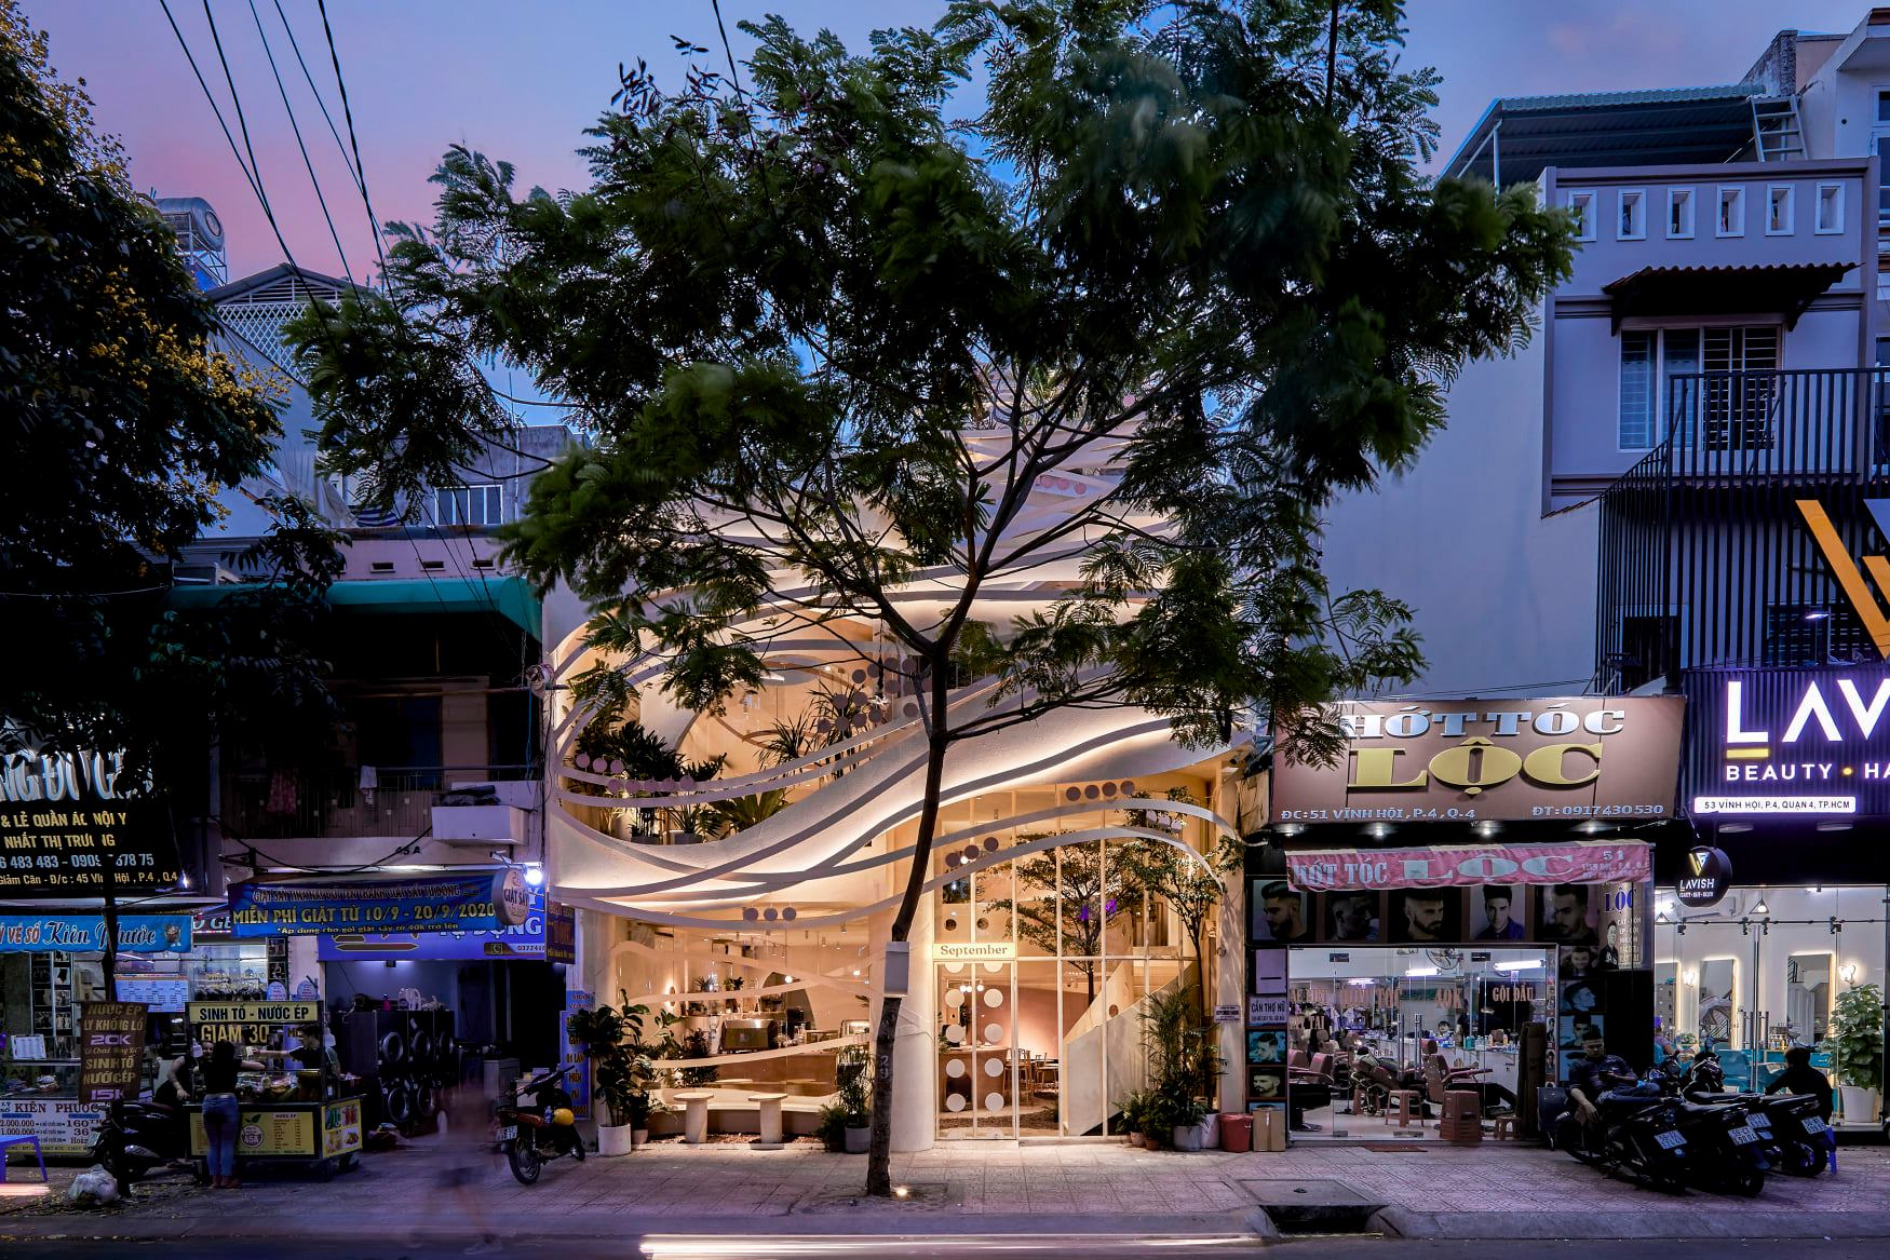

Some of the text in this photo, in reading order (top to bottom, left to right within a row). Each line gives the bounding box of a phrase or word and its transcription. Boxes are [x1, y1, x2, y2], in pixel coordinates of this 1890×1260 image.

[1484, 702, 1625, 736] TÓC
[1347, 736, 1604, 796] LỘC
[1726, 763, 1832, 781] BEAUTY
[1704, 801, 1716, 810] 53
[1818, 801, 1850, 810] TP.HCM
[0, 814, 11, 828] &
[92, 810, 116, 828] NỘI
[117, 812, 127, 825] Y
[10, 855, 33, 869] 483
[36, 855, 59, 869] 483
[138, 853, 154, 866] 75
[1345, 857, 1388, 884] TÓC
[1399, 850, 1575, 887] LỘC
[77, 873, 89, 884] 45
[1680, 878, 1715, 892] LAVISH
[233, 904, 269, 924] MIỄN
[273, 906, 297, 923] PHÍ
[301, 906, 336, 925] GIẶT
[341, 905, 360, 922] TỪ
[365, 906, 400, 921] 10/9
[414, 902, 496, 920] 20/9/2020
[24, 920, 42, 944] SỐ
[940, 944, 1008, 957] September
[1492, 983, 1534, 1004] GỘI ĐẦU
[200, 1008, 228, 1020] SINH
[231, 1003, 246, 1020] TỐ
[257, 1004, 290, 1020] NƯỚC
[294, 1003, 310, 1020] ÉP
[91, 1034, 131, 1046] 20K
[86, 1054, 135, 1070] SINH TỐ
[91, 1088, 126, 1101] 15K
[66, 1119, 90, 1128] 160
[73, 1128, 90, 1136] 36
